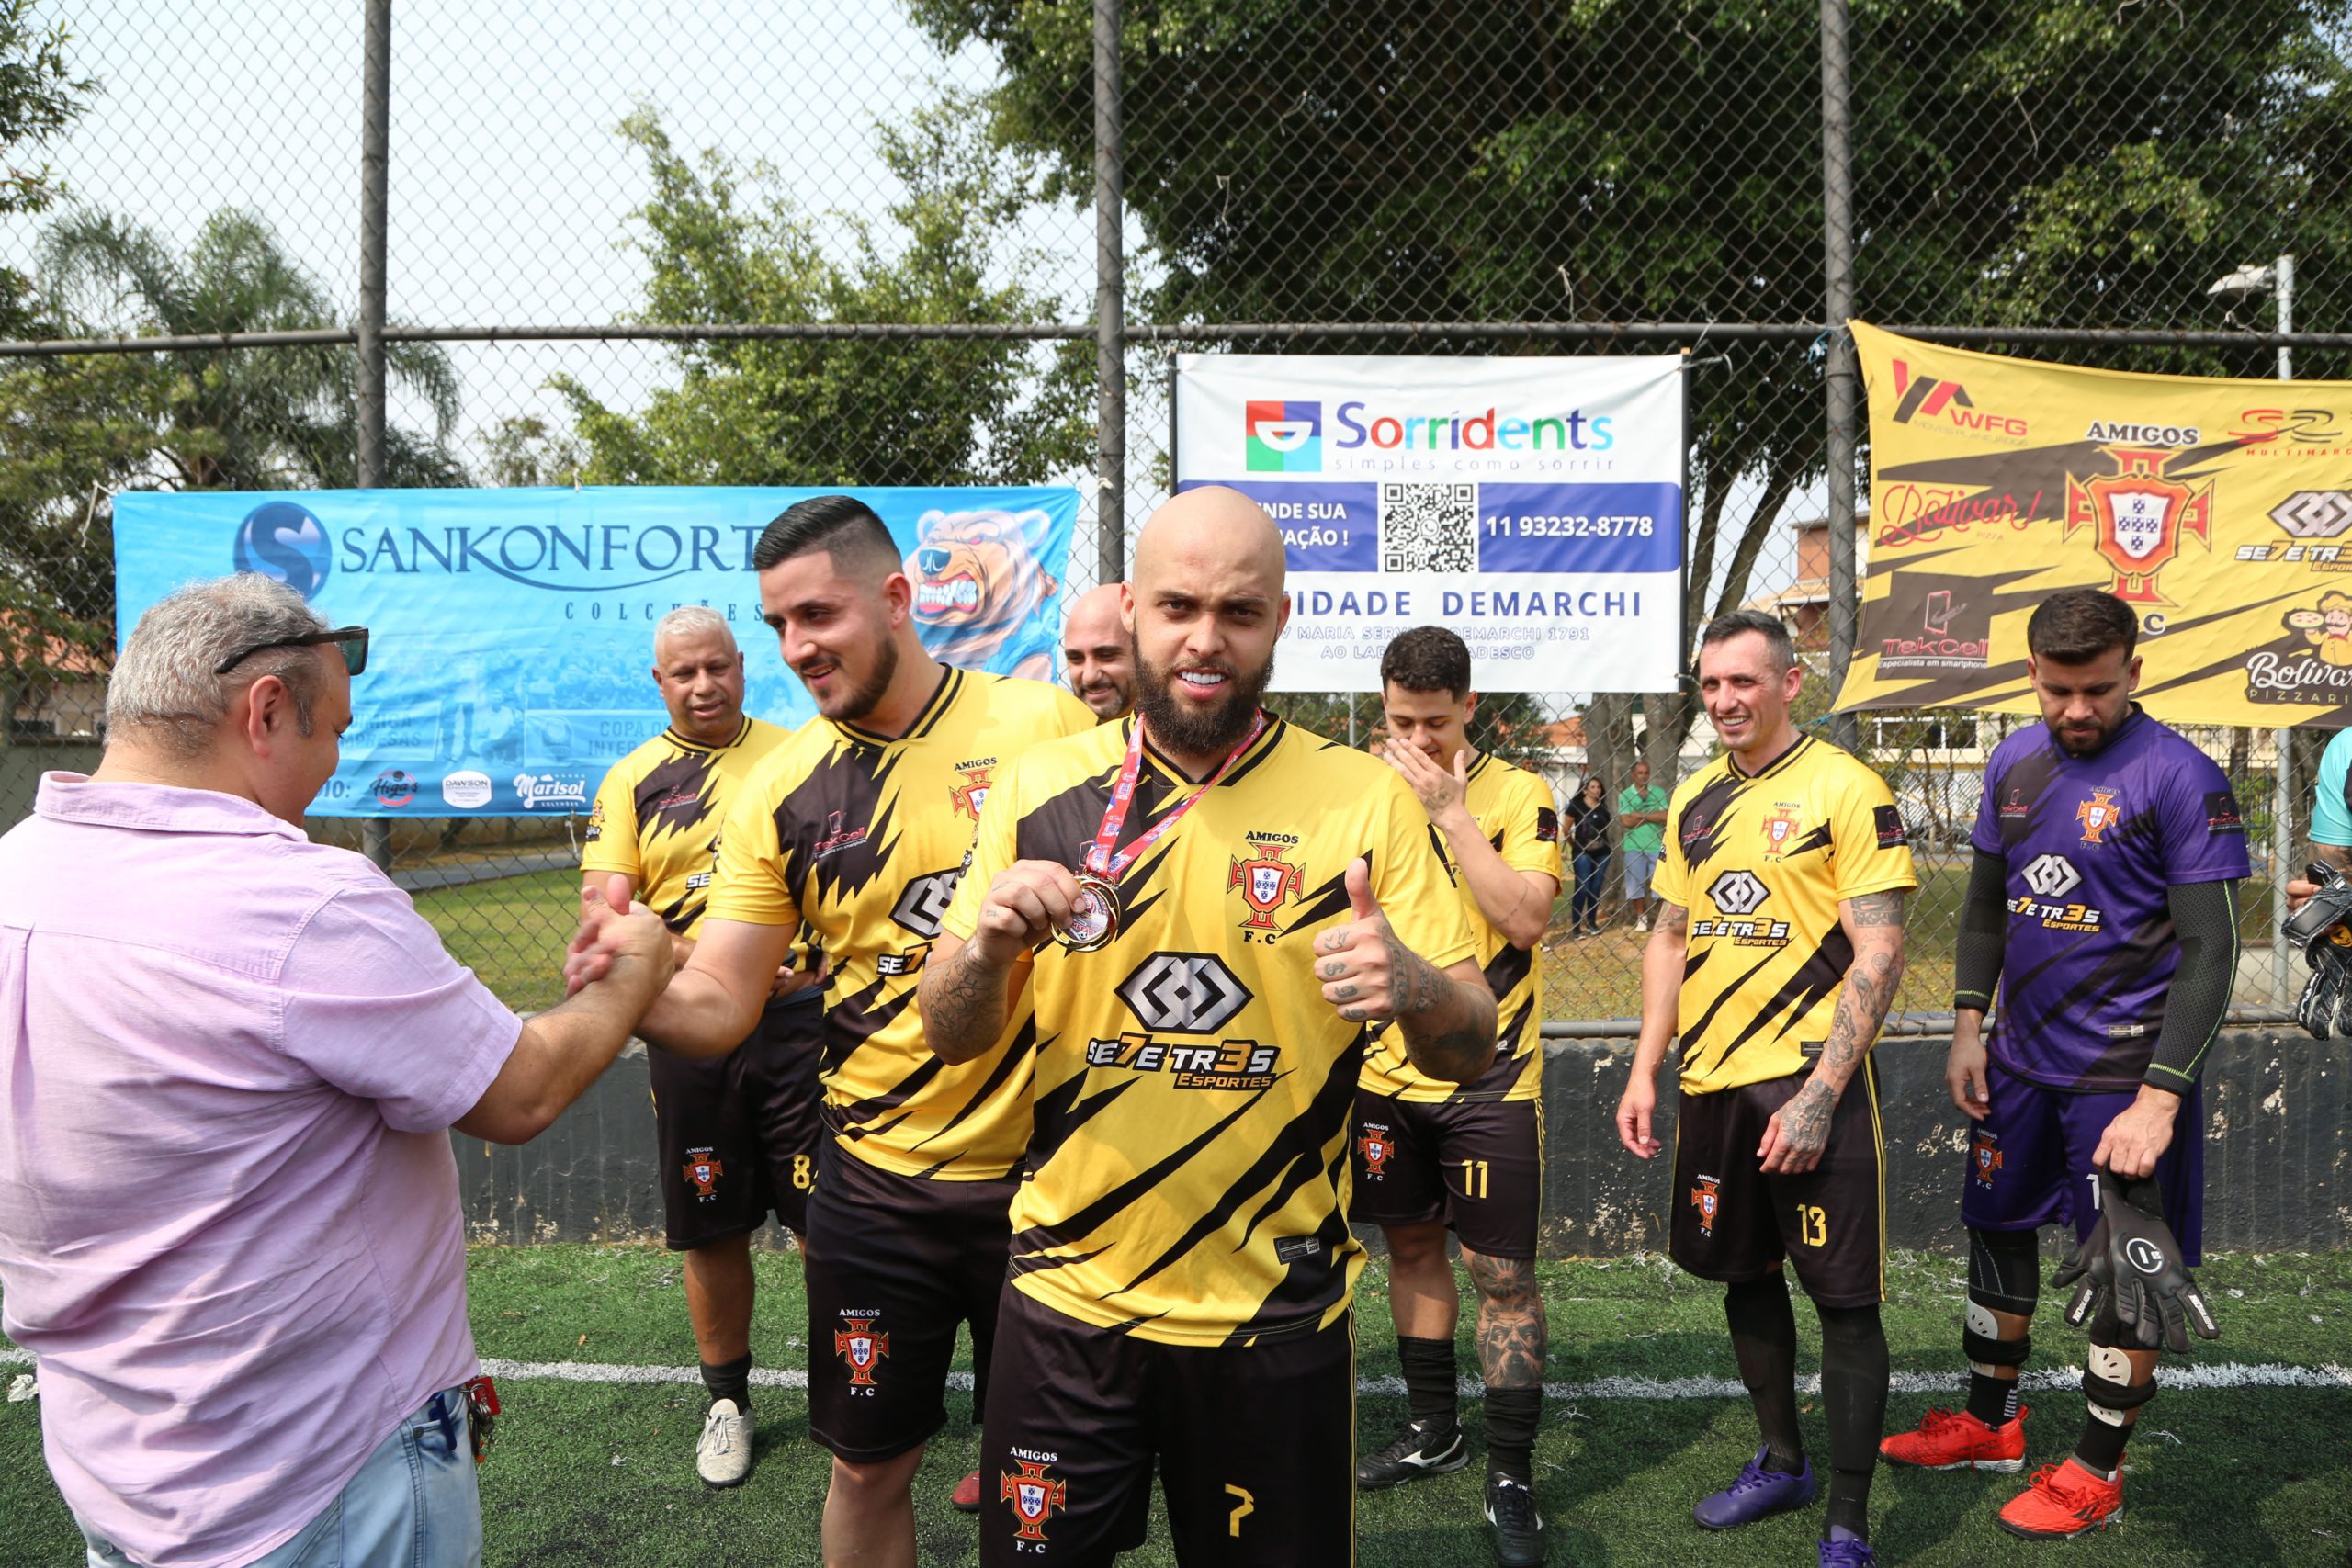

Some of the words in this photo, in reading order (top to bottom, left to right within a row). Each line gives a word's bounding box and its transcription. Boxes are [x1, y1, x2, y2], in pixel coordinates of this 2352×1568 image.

[1335, 400, 1614, 451] Sorridents
[1950, 408, 2028, 436] WFG
[2086, 421, 2201, 446] AMIGOS
[1335, 457, 1436, 473] simples
[1454, 459, 1520, 470] como
[1538, 457, 1614, 470] sorrir
[1258, 502, 1304, 520] NDE
[1307, 502, 1347, 520] SUA
[1486, 517, 1510, 536] 11
[1519, 515, 1654, 537] 93232-8778
[1279, 525, 1339, 550] AÇÃO
[1342, 529, 1349, 547] !
[2234, 540, 2304, 562] SE7E
[1283, 591, 1411, 615] IDADE
[1442, 592, 1640, 616] DEMARCHI
[1297, 626, 1356, 640] MARIA
[1548, 627, 1590, 640] 1791
[1320, 646, 1347, 659] AO
[1353, 646, 1385, 659] LAD
[1467, 646, 1535, 660] ADESCO
[1881, 636, 1990, 657] TekCell
[1878, 660, 1925, 669] Especialista
[954, 757, 998, 772] AMIGOS
[513, 773, 586, 809] Marisol
[1773, 801, 1801, 809] AMIGOS
[1245, 830, 1299, 844] AMIGOS
[2007, 897, 2038, 916] SE7E
[2041, 903, 2100, 924] TR3S
[1732, 918, 1789, 938] TR3S
[877, 942, 933, 975] SE7
[1088, 1033, 1166, 1069] SE7E
[1170, 1041, 1274, 1074] TR3S
[1363, 1122, 1389, 1131] AMIGOS
[1976, 1127, 1998, 1140] AMIGOS
[793, 1154, 810, 1190] 8
[1461, 1159, 1488, 1199] 11
[1697, 1174, 1720, 1184] AMIGOS
[1796, 1203, 1827, 1247] 13
[839, 1308, 881, 1317] AMIGOS
[1010, 1446, 1058, 1461] AMIGOS
